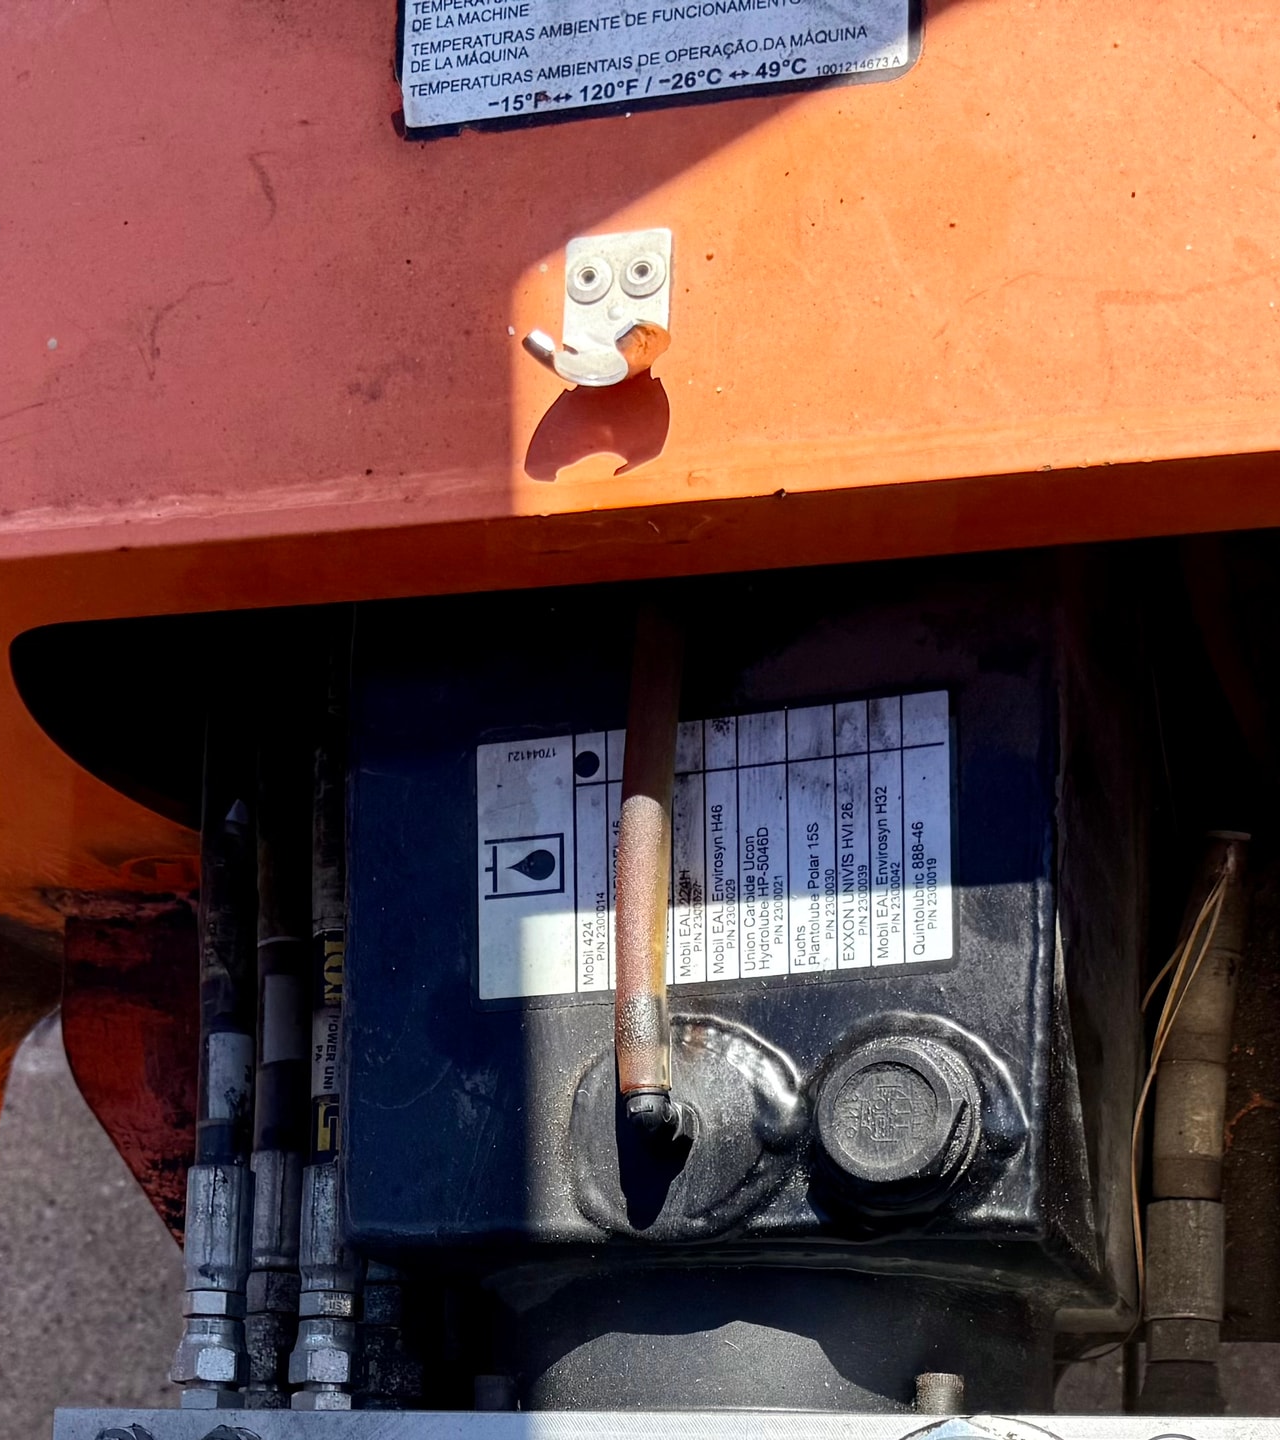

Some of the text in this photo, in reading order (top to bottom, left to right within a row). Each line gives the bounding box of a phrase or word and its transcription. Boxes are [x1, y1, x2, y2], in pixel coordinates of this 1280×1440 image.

[412, 4, 529, 32] DE LA MACHINE
[412, 27, 534, 56] TEMPERATURAS
[538, 15, 619, 39] AMBIENTE
[625, 12, 647, 27] DE
[409, 23, 867, 97] TEMPERATURAS AMBIENTAIS DE OPERAÇÃO DA MÁQUINA
[410, 44, 528, 73] DE LA MÁQUINA
[579, 78, 638, 103] 120°F
[645, 76, 652, 94] /
[755, 56, 806, 79] 49°C
[508, 746, 556, 762] 1704412J
[711, 804, 726, 973] Mobil EAL Envirosyn H46
[743, 835, 755, 970] Union Carbide Ucon
[757, 826, 771, 969] Hydrolube HP-5046D
[807, 821, 820, 965] Plantolube Polar 15S
[824, 868, 835, 939] P/N 2300030
[841, 802, 855, 961] EXXON UNIVIS HVI 26
[857, 864, 867, 935] P/N 2300039
[875, 785, 890, 958] Mobil EAL Envirosyn H32
[890, 862, 900, 932] P/N 2300042
[911, 821, 926, 955] Quintolubric 888-46
[927, 857, 937, 929] P/N 2300019
[596, 892, 605, 960] P/N 2300014
[679, 869, 690, 976] Mobil EAL 224H
[693, 932, 702, 952] P/N
[726, 878, 735, 949] P/N 2300029
[773, 874, 783, 944] P/N 2300021
[582, 921, 594, 985] Mobil 424
[794, 925, 806, 966] Fuchs
